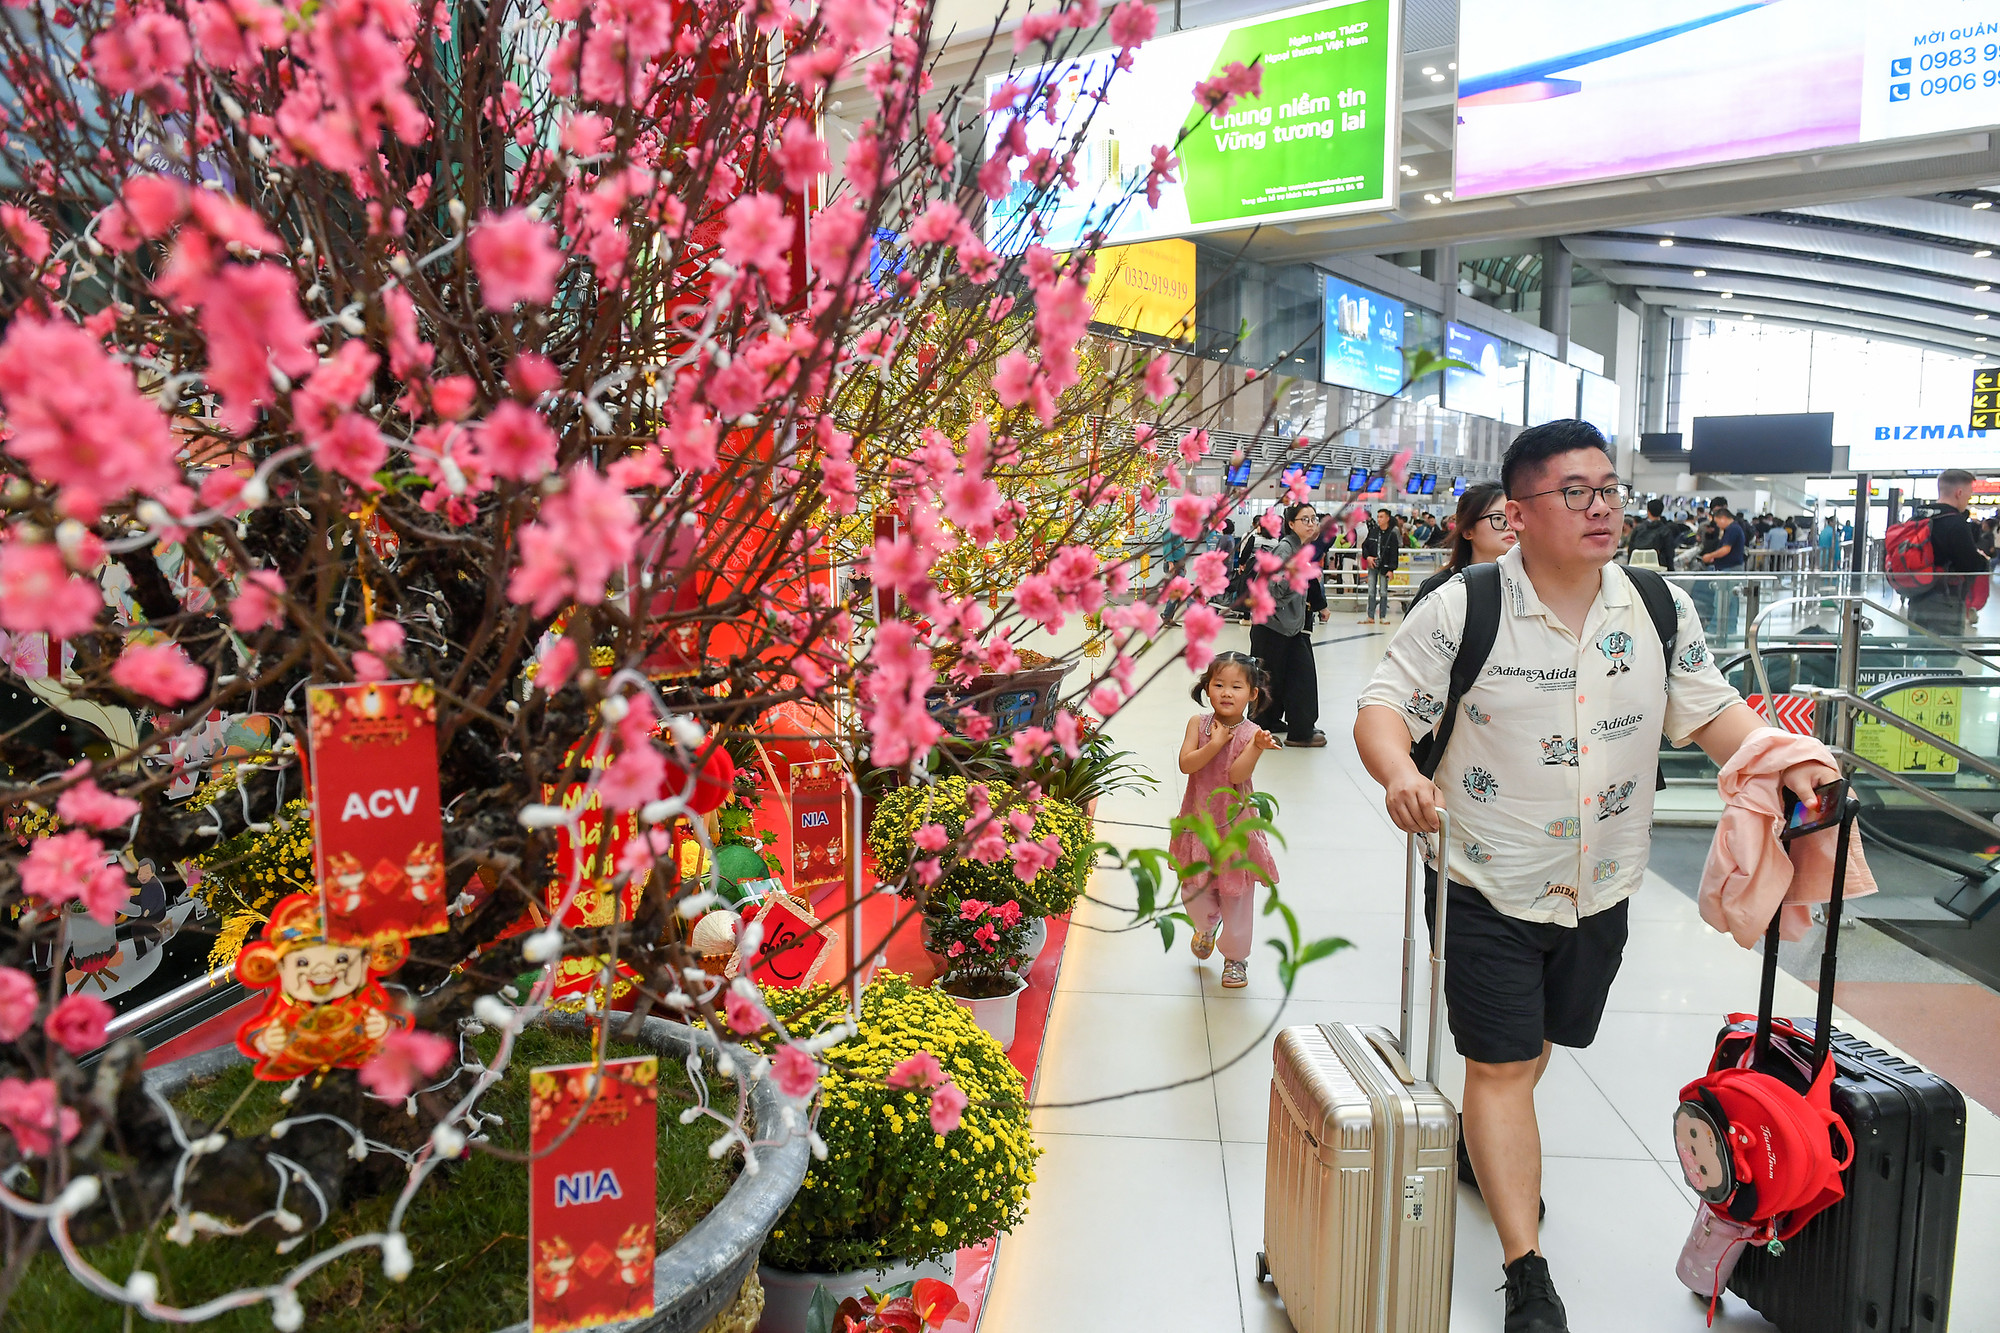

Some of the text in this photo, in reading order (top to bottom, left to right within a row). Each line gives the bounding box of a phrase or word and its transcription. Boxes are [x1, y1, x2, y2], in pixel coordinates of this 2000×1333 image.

[1338, 22, 1368, 36] TMCP
[1914, 31, 1945, 46] MỜI
[1325, 39, 1344, 51] Việt
[1346, 36, 1368, 47] Nam
[1920, 47, 1976, 71] 0983
[1920, 73, 1976, 96] 0906
[1210, 87, 1366, 130] Chung niềm tin
[1214, 109, 1366, 152] Vững tương lai
[1125, 266, 1188, 301] 0332.919.919
[1875, 424, 1987, 440] BIZMAN
[1487, 665, 1532, 677] Adidas
[1590, 714, 1643, 735] Adidas
[341, 787, 419, 822] ACV
[802, 810, 829, 828] NIA
[555, 1168, 622, 1208] NIA
